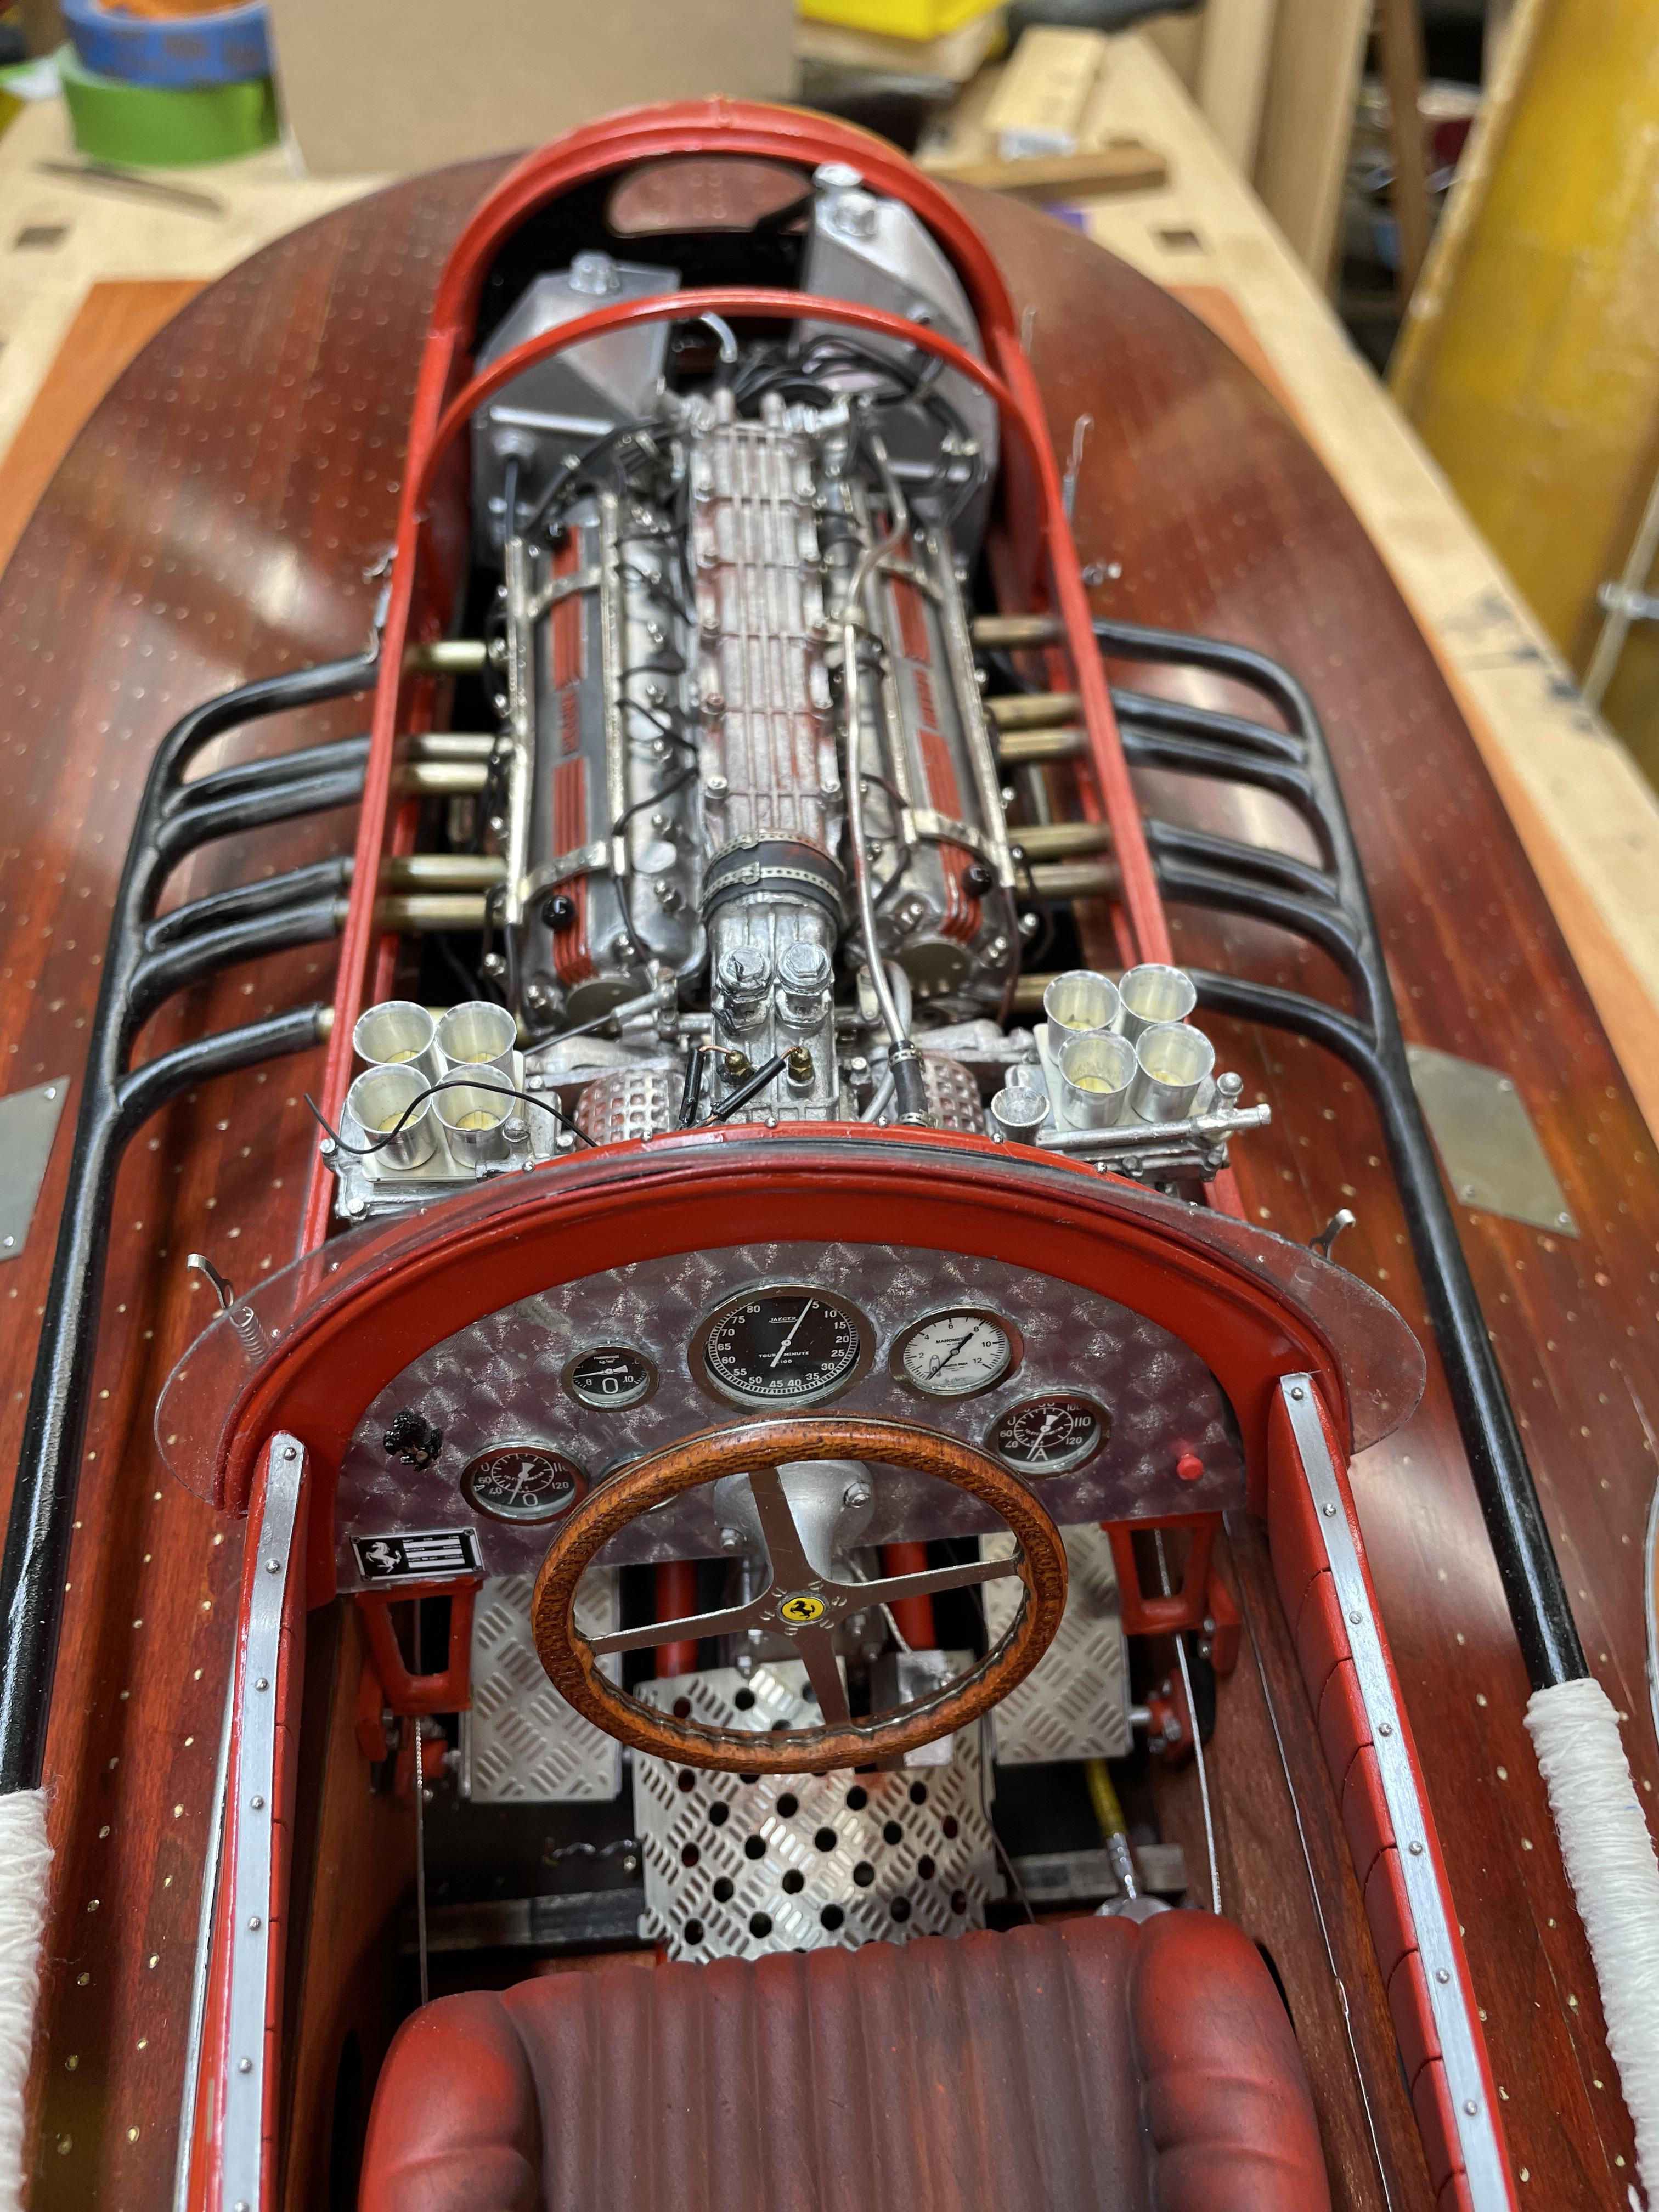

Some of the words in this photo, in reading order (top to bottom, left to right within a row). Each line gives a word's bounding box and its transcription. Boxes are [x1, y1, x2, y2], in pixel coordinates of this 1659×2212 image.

[731, 1316, 745, 1324] 75
[721, 1356, 736, 1364] 60
[821, 1363, 835, 1371] 30
[769, 1380, 783, 1388] 45
[787, 1379, 802, 1387] 40
[1074, 1417, 1091, 1427] 110
[1066, 1437, 1082, 1445] 120
[1031, 1448, 1048, 1462] A
[552, 1481, 569, 1489] 120
